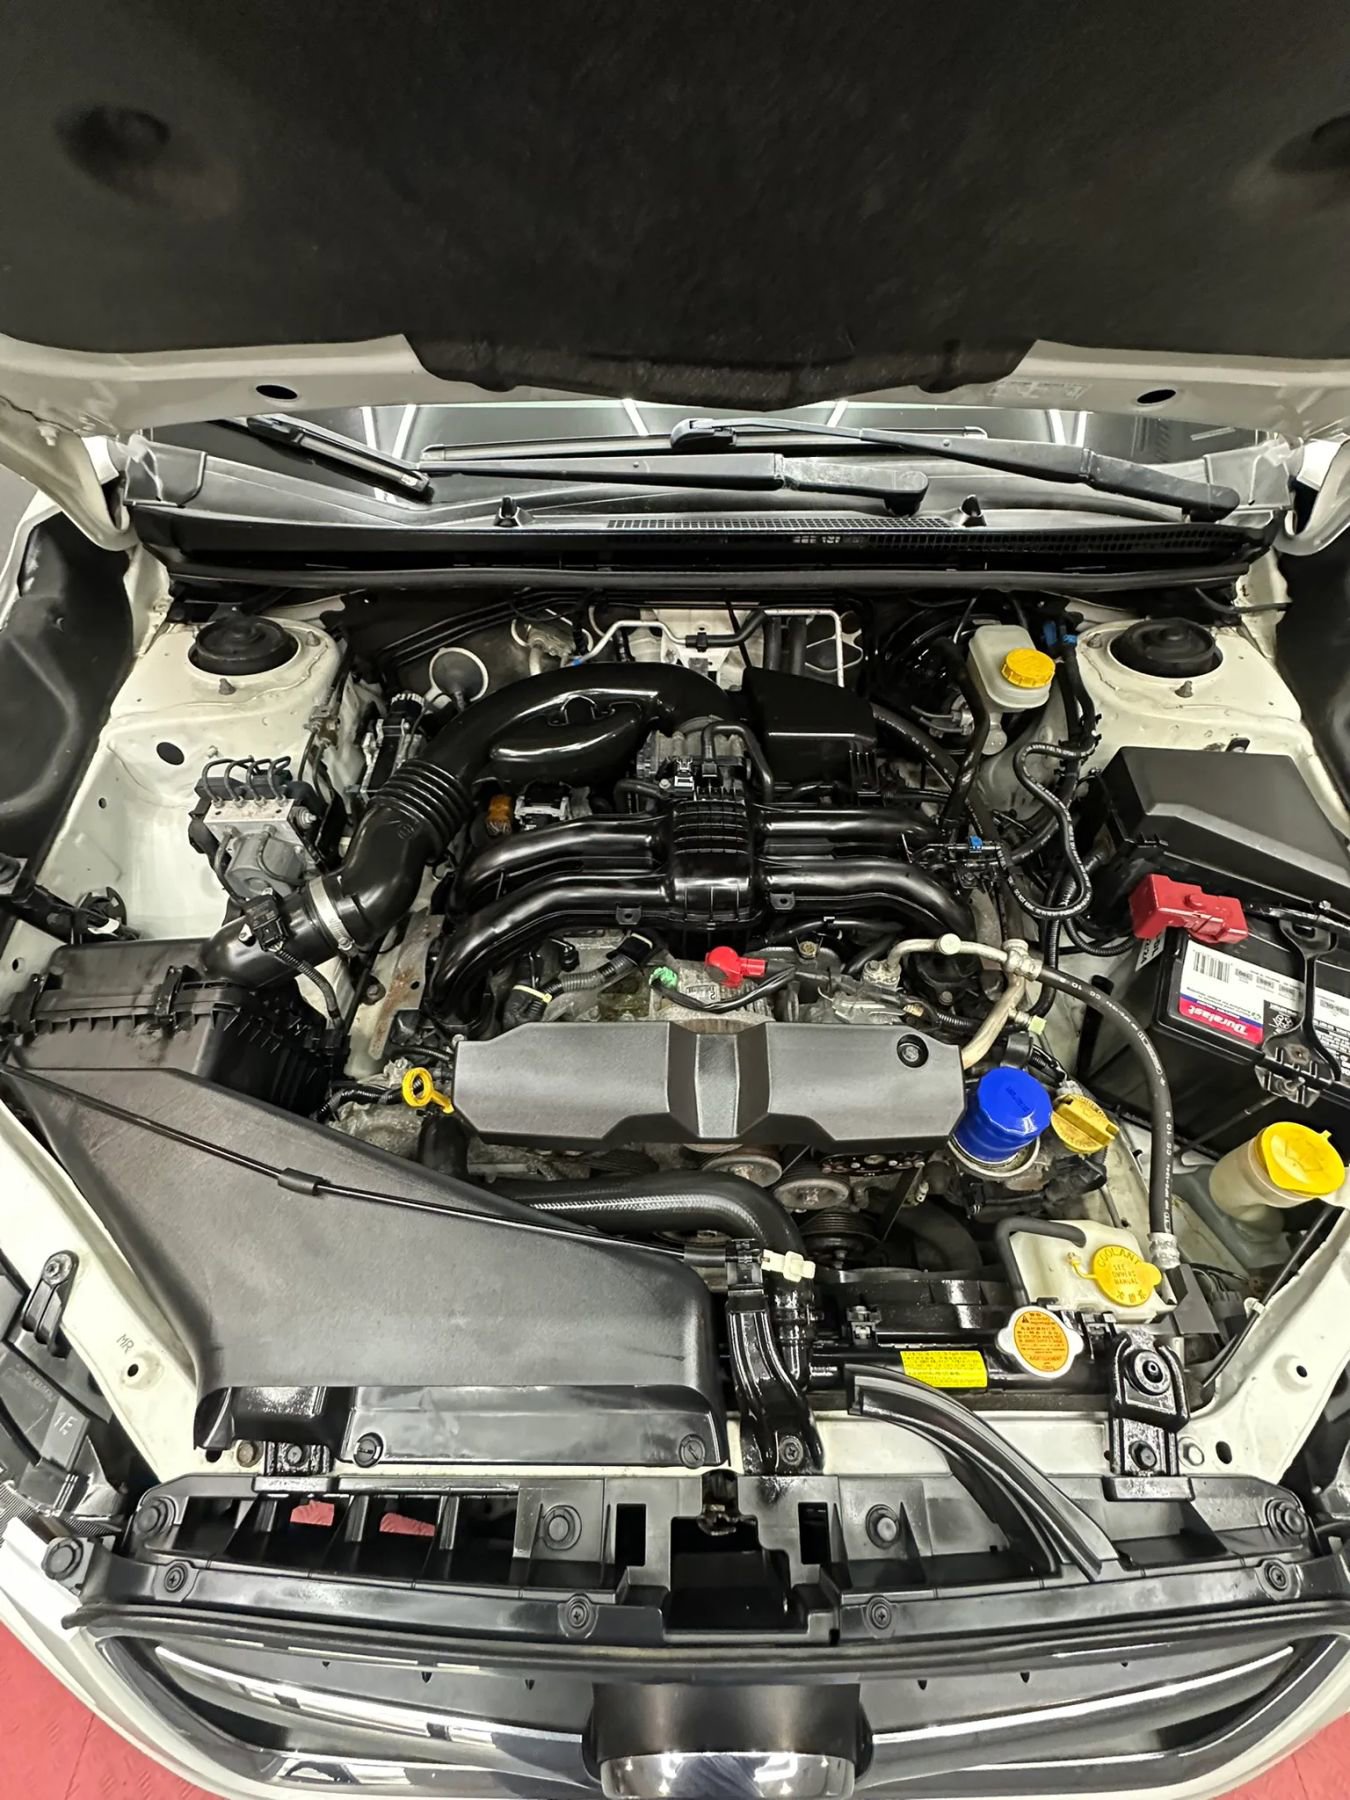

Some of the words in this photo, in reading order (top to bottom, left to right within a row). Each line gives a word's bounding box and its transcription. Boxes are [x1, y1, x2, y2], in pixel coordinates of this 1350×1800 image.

[1188, 1005, 1248, 1036] Duralast
[1097, 1247, 1141, 1268] COOLANT
[116, 1333, 135, 1354] MR
